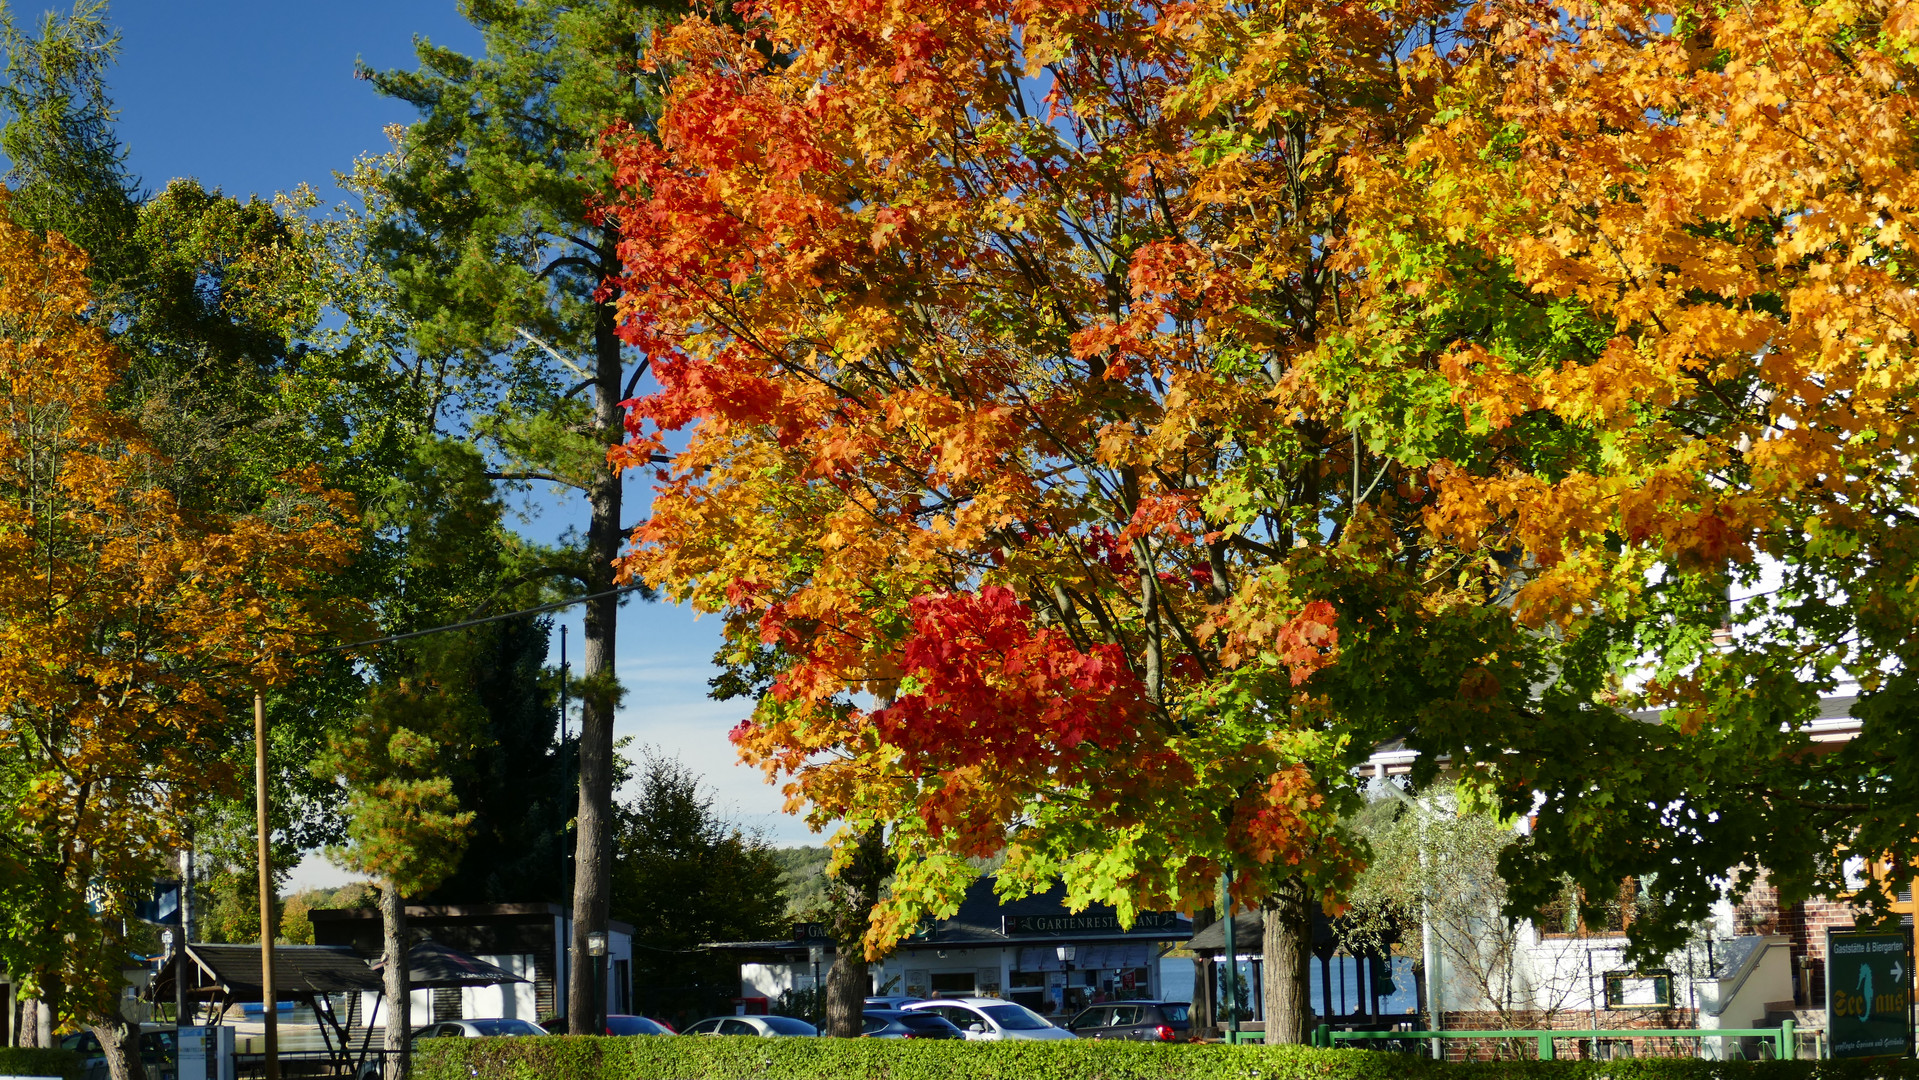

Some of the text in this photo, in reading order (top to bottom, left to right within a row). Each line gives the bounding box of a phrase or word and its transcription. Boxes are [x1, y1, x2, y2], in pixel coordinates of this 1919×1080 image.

[1833, 941, 1904, 954] Gaststätte & Biergarten
